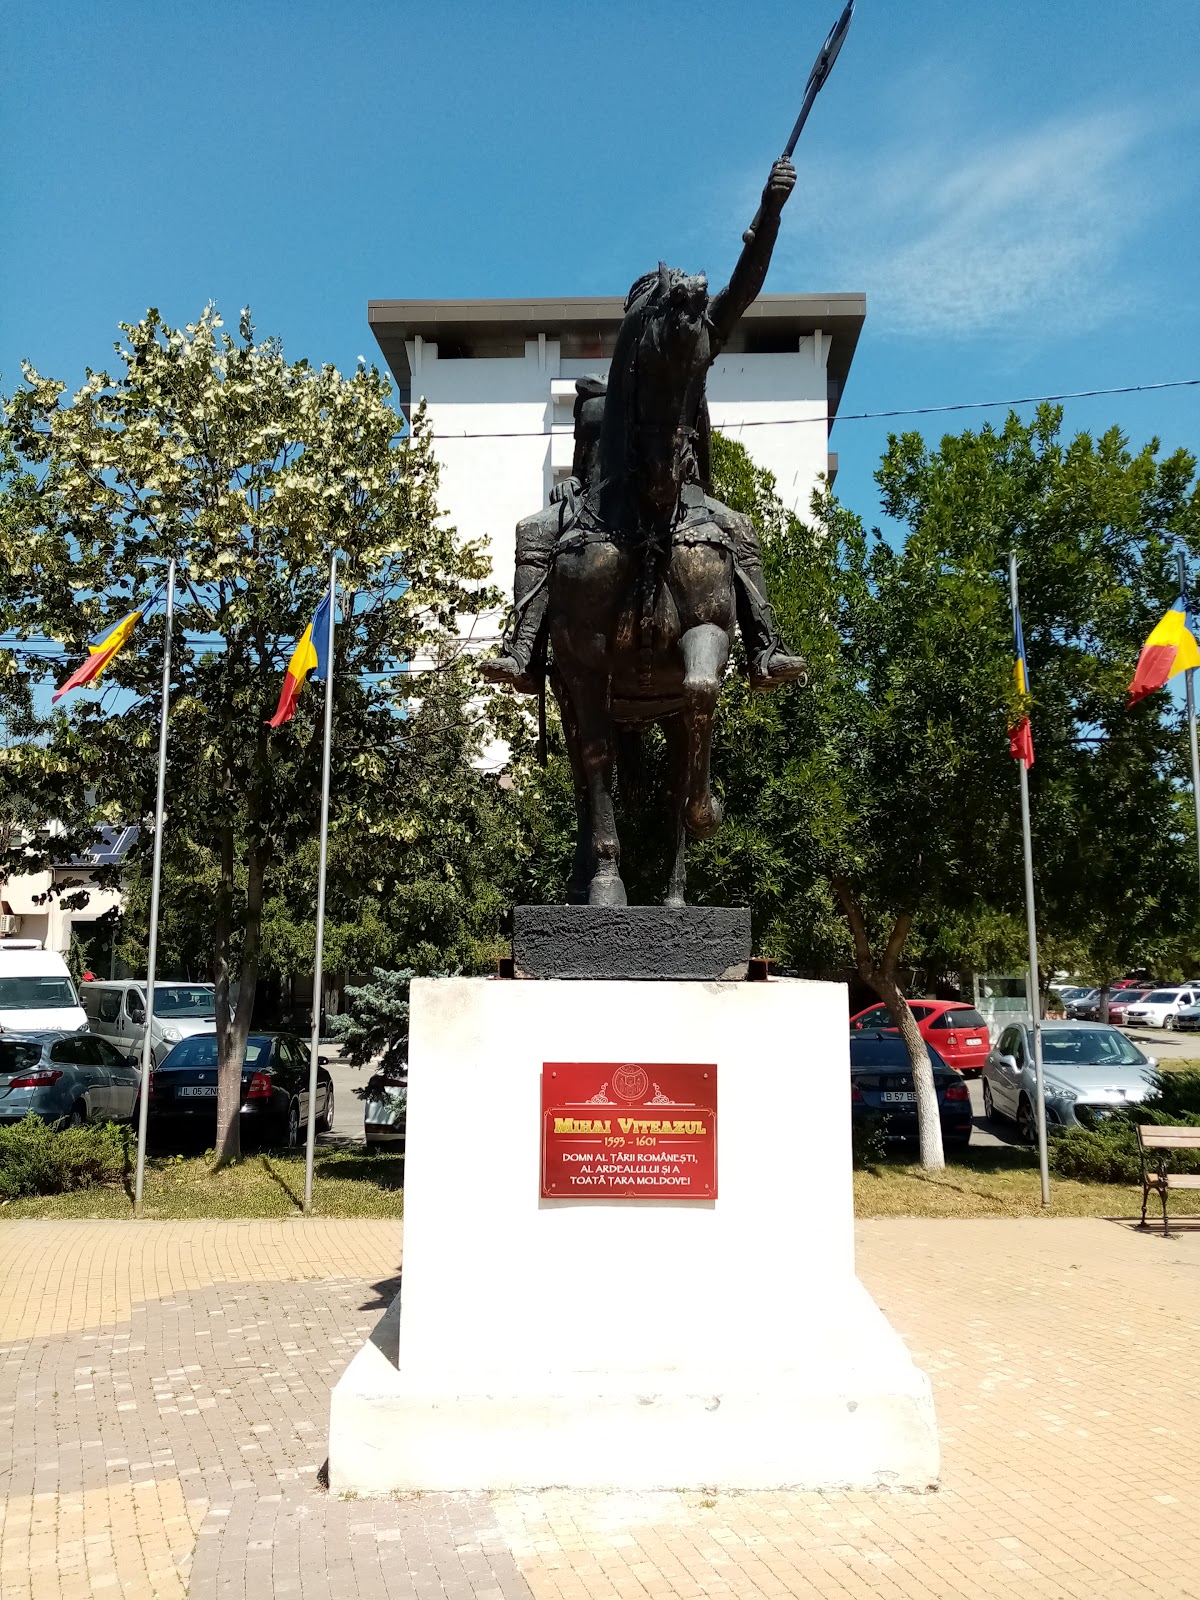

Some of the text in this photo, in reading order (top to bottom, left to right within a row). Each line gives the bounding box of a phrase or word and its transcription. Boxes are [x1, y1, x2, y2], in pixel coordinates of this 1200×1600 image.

[554, 1118, 706, 1134] MIHAI VITEAZUL
[604, 1137, 625, 1148] 1593
[636, 1136, 656, 1146] 1601
[562, 1153, 594, 1162] DOMN
[595, 1154, 608, 1162] AL
[580, 1165, 594, 1173] AL
[595, 1165, 659, 1173] ARDEALULUI
[570, 1175, 605, 1184] TOATĂ
[637, 1177, 690, 1185] MOLDOVEI
